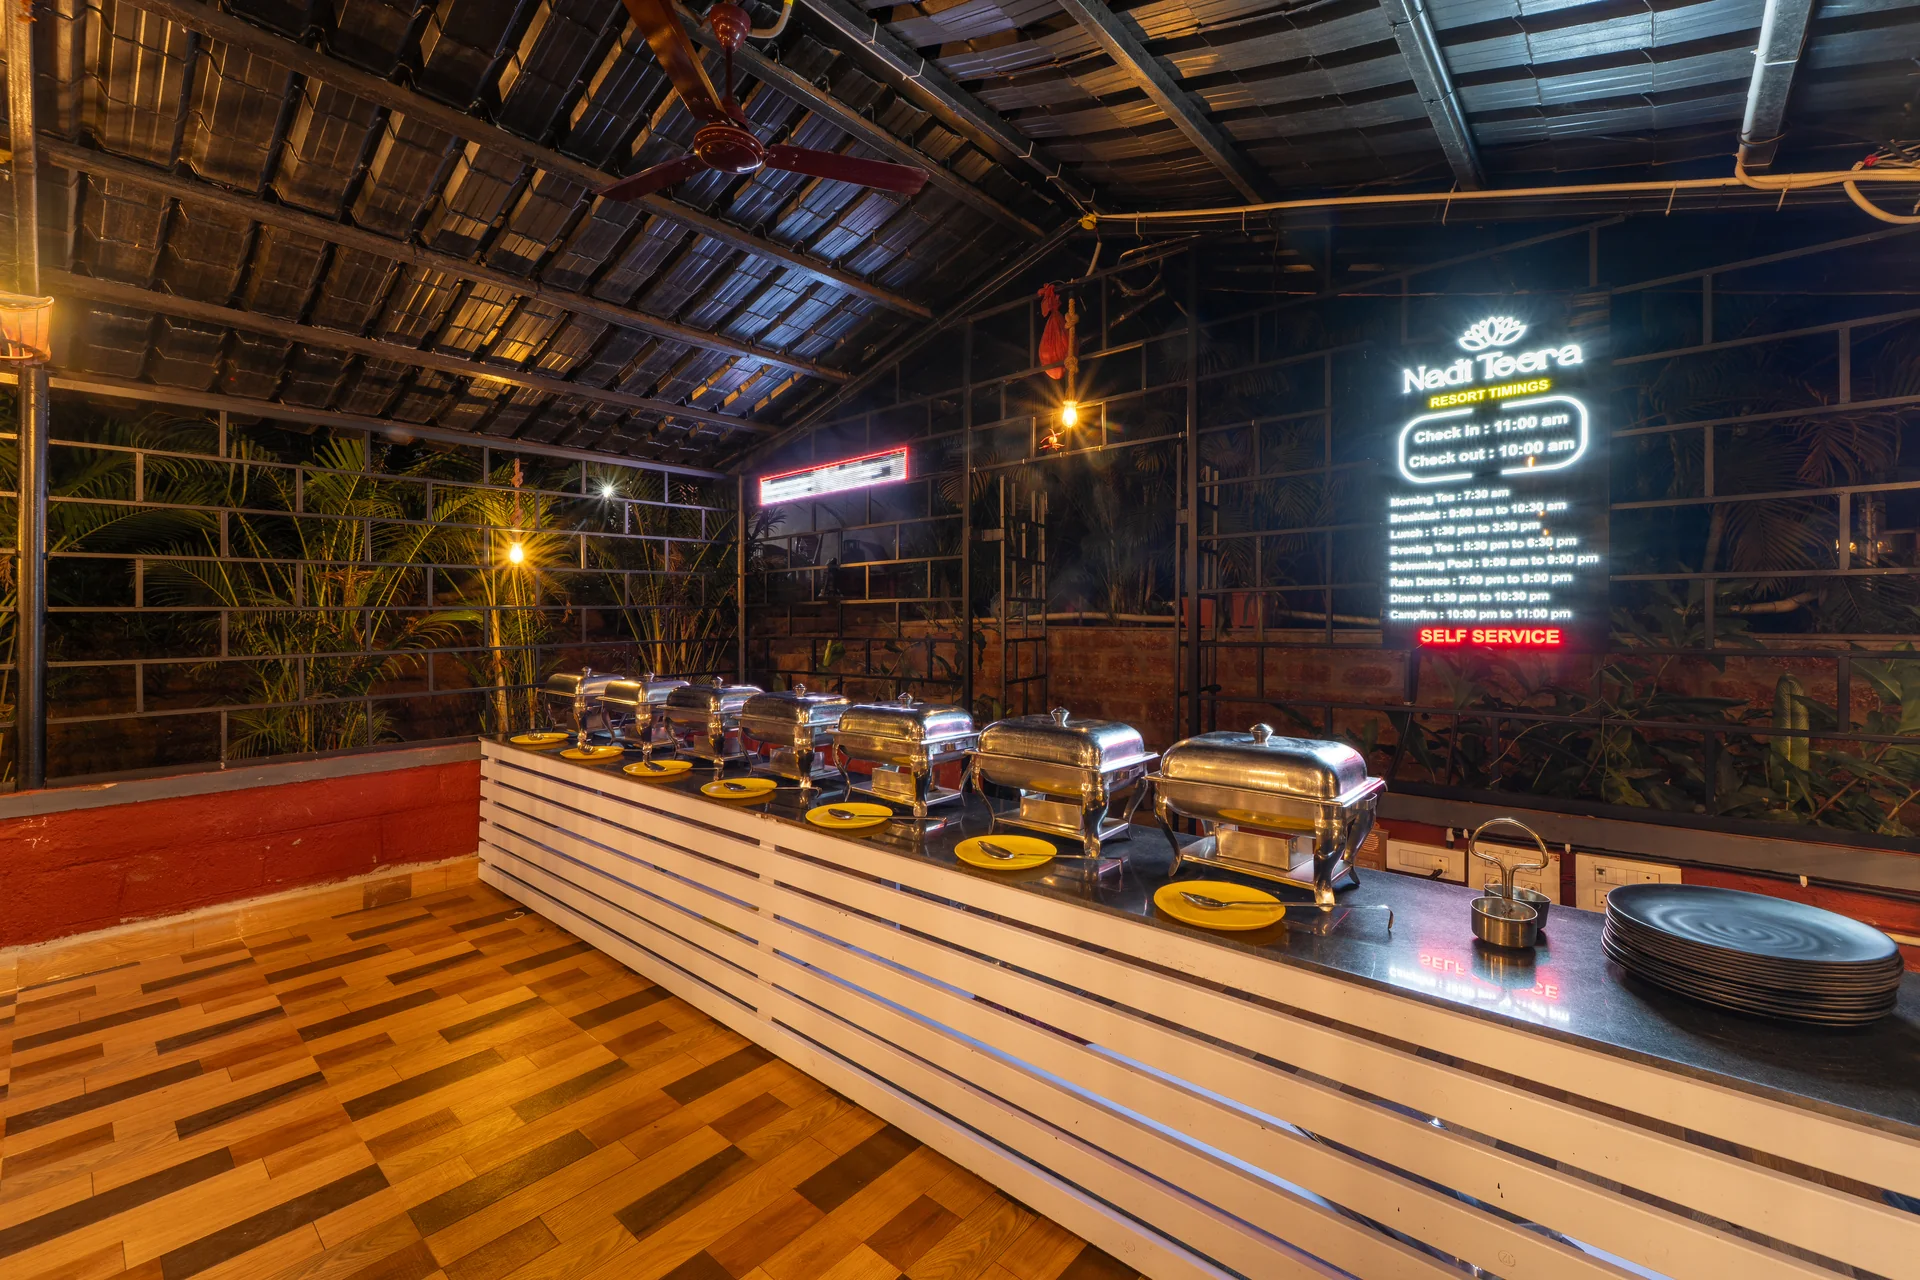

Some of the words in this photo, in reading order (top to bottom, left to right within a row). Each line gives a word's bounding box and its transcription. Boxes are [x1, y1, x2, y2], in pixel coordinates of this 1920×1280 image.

[1403, 359, 1473, 394] Nadi
[1477, 344, 1583, 380] Teera
[1430, 390, 1485, 408] RESORT
[1489, 380, 1550, 398] TIMINGS
[1415, 426, 1461, 443] Check
[1465, 425, 1480, 436] in
[1484, 425, 1489, 434] :
[1495, 416, 1538, 433] 11:00
[1542, 414, 1568, 426] am
[1409, 451, 1455, 468] Check
[1459, 449, 1485, 461] out
[1490, 450, 1494, 458] :
[1499, 441, 1544, 457] 10:00
[1548, 439, 1575, 451] am
[1390, 495, 1433, 507] Morning
[1436, 493, 1455, 502] Tea
[1464, 490, 1488, 499] 7:30
[1491, 489, 1509, 498] am
[1390, 511, 1440, 523] Breakfast
[1496, 505, 1508, 514] to
[1511, 502, 1544, 513] 10:30
[1547, 502, 1567, 510] am
[1390, 529, 1422, 539] Lunch
[1432, 526, 1455, 536] 1:30
[1458, 525, 1475, 536] pm
[1478, 525, 1490, 533] to
[1492, 522, 1517, 532] 3:30
[1521, 521, 1540, 532] pm
[1390, 545, 1433, 555] Evening
[1435, 543, 1454, 552] Tea
[1464, 542, 1487, 550] 5:30
[1490, 542, 1509, 551] pm
[1512, 539, 1524, 548] to
[1527, 538, 1553, 547] 6:30
[1557, 538, 1577, 547] pm
[1390, 560, 1445, 571] Swimming
[1447, 559, 1472, 568] Pool
[1510, 558, 1528, 566] am
[1532, 556, 1544, 565] to
[1547, 555, 1574, 564] 9:00
[1578, 555, 1599, 565] pm
[1390, 578, 1413, 586] Rain
[1416, 577, 1449, 586] Dance
[1459, 576, 1483, 584] 7:00
[1485, 576, 1504, 585] pm
[1507, 575, 1520, 583] to
[1552, 574, 1572, 584] pm
[1390, 594, 1424, 603] Dinner
[1459, 594, 1477, 603] pm
[1480, 593, 1492, 601] to
[1495, 592, 1526, 601] 10:30
[1530, 592, 1549, 602] pm
[1390, 610, 1437, 620] Campfire
[1447, 610, 1476, 618] 10:00
[1479, 611, 1497, 620] pm
[1500, 610, 1513, 618] to
[1516, 609, 1548, 618] 11:00
[1551, 610, 1571, 619] pm
[1421, 630, 1466, 643] SELF
[1473, 630, 1560, 644] SERVICE
